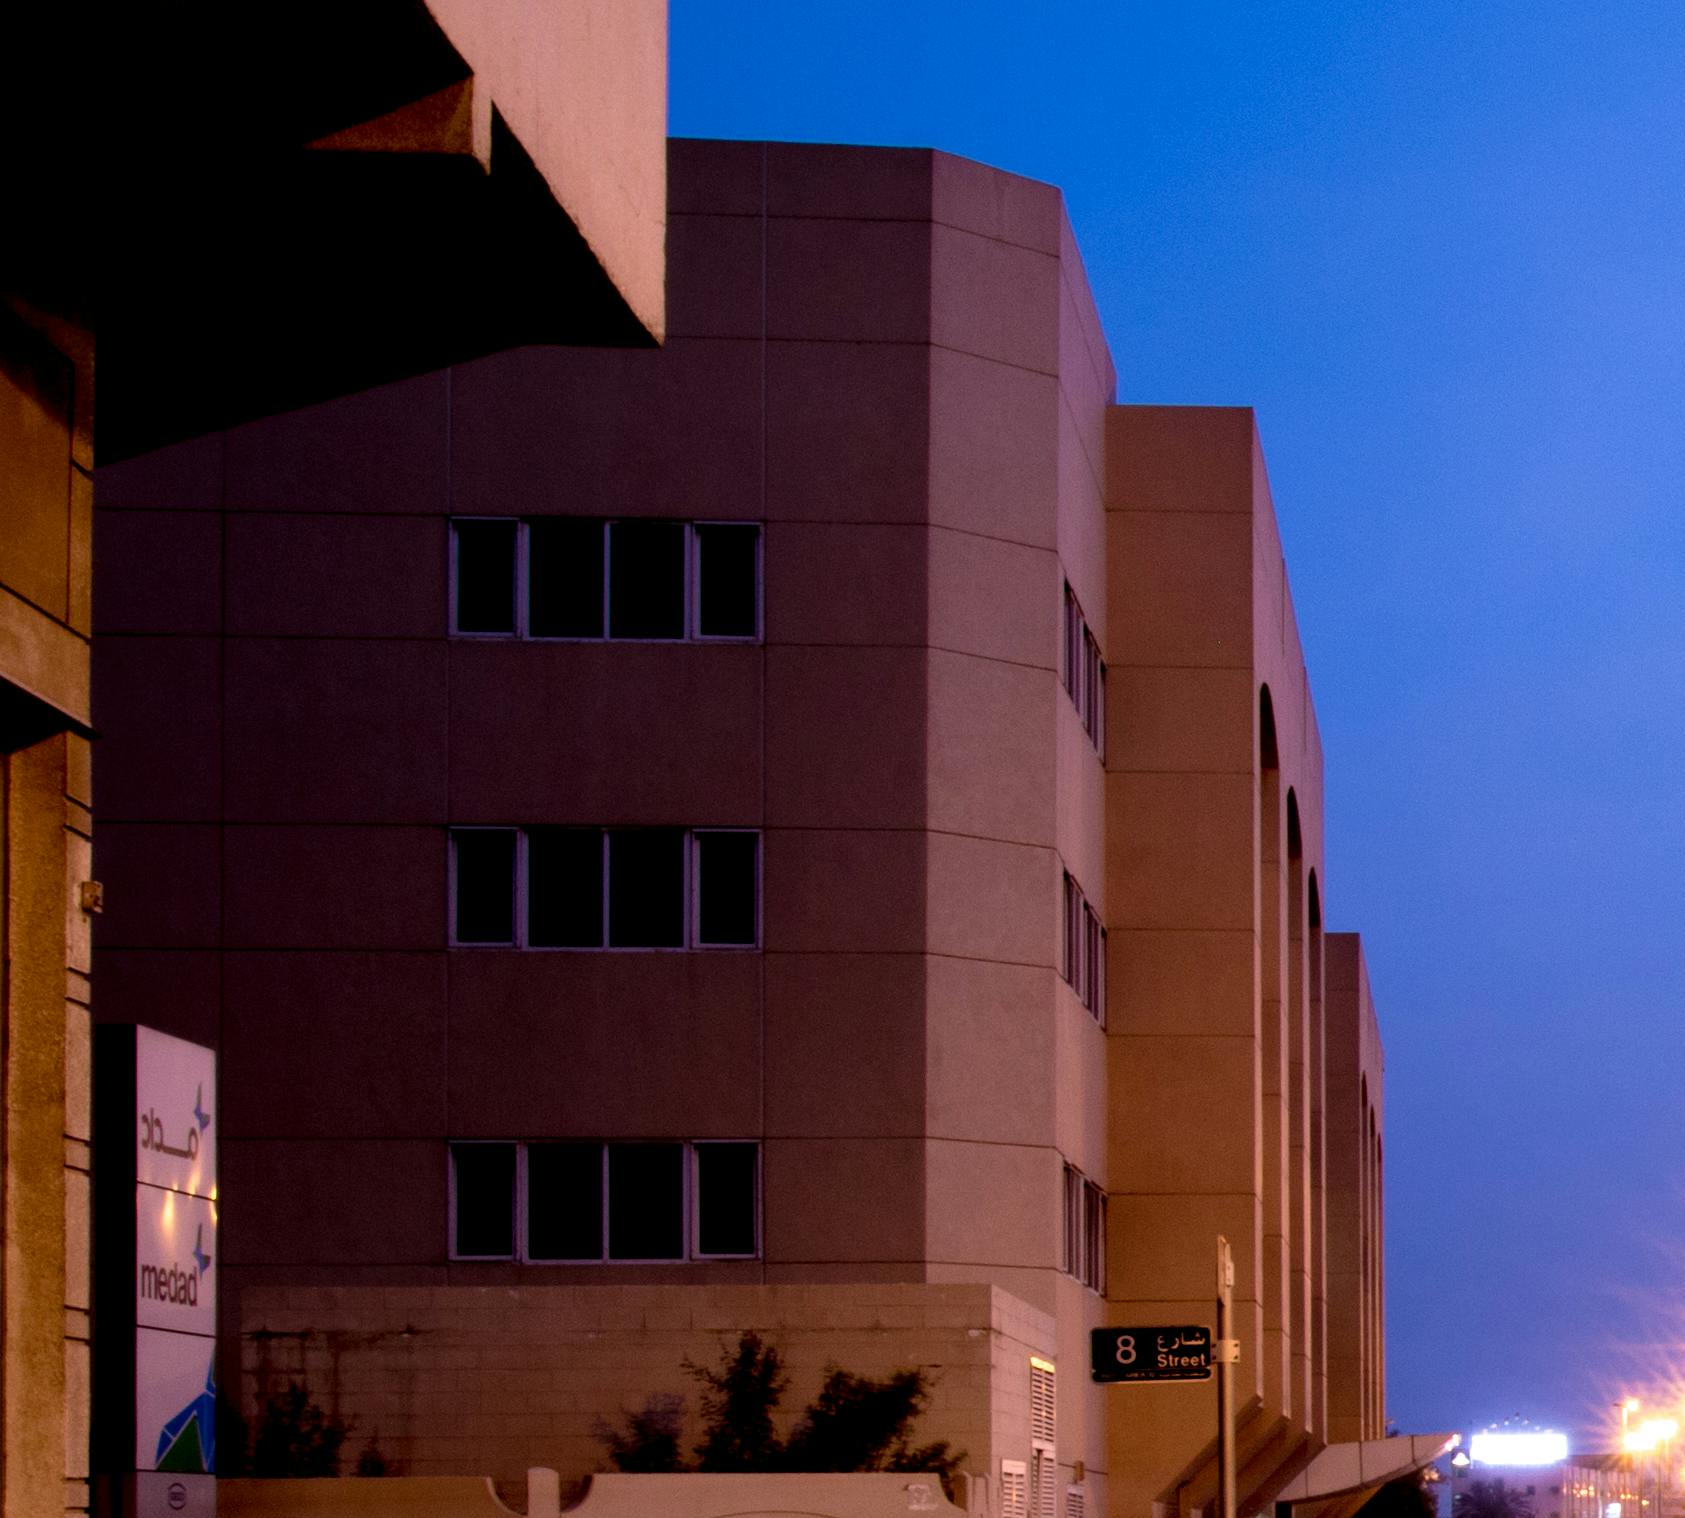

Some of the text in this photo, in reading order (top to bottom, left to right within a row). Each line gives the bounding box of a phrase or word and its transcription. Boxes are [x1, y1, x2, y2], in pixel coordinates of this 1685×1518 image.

[141, 1108, 199, 1161] مداد
[141, 1262, 199, 1307] medad
[1115, 1334, 1137, 1365] 8
[1157, 1331, 1206, 1352] شارع
[1157, 1353, 1206, 1367] Street
